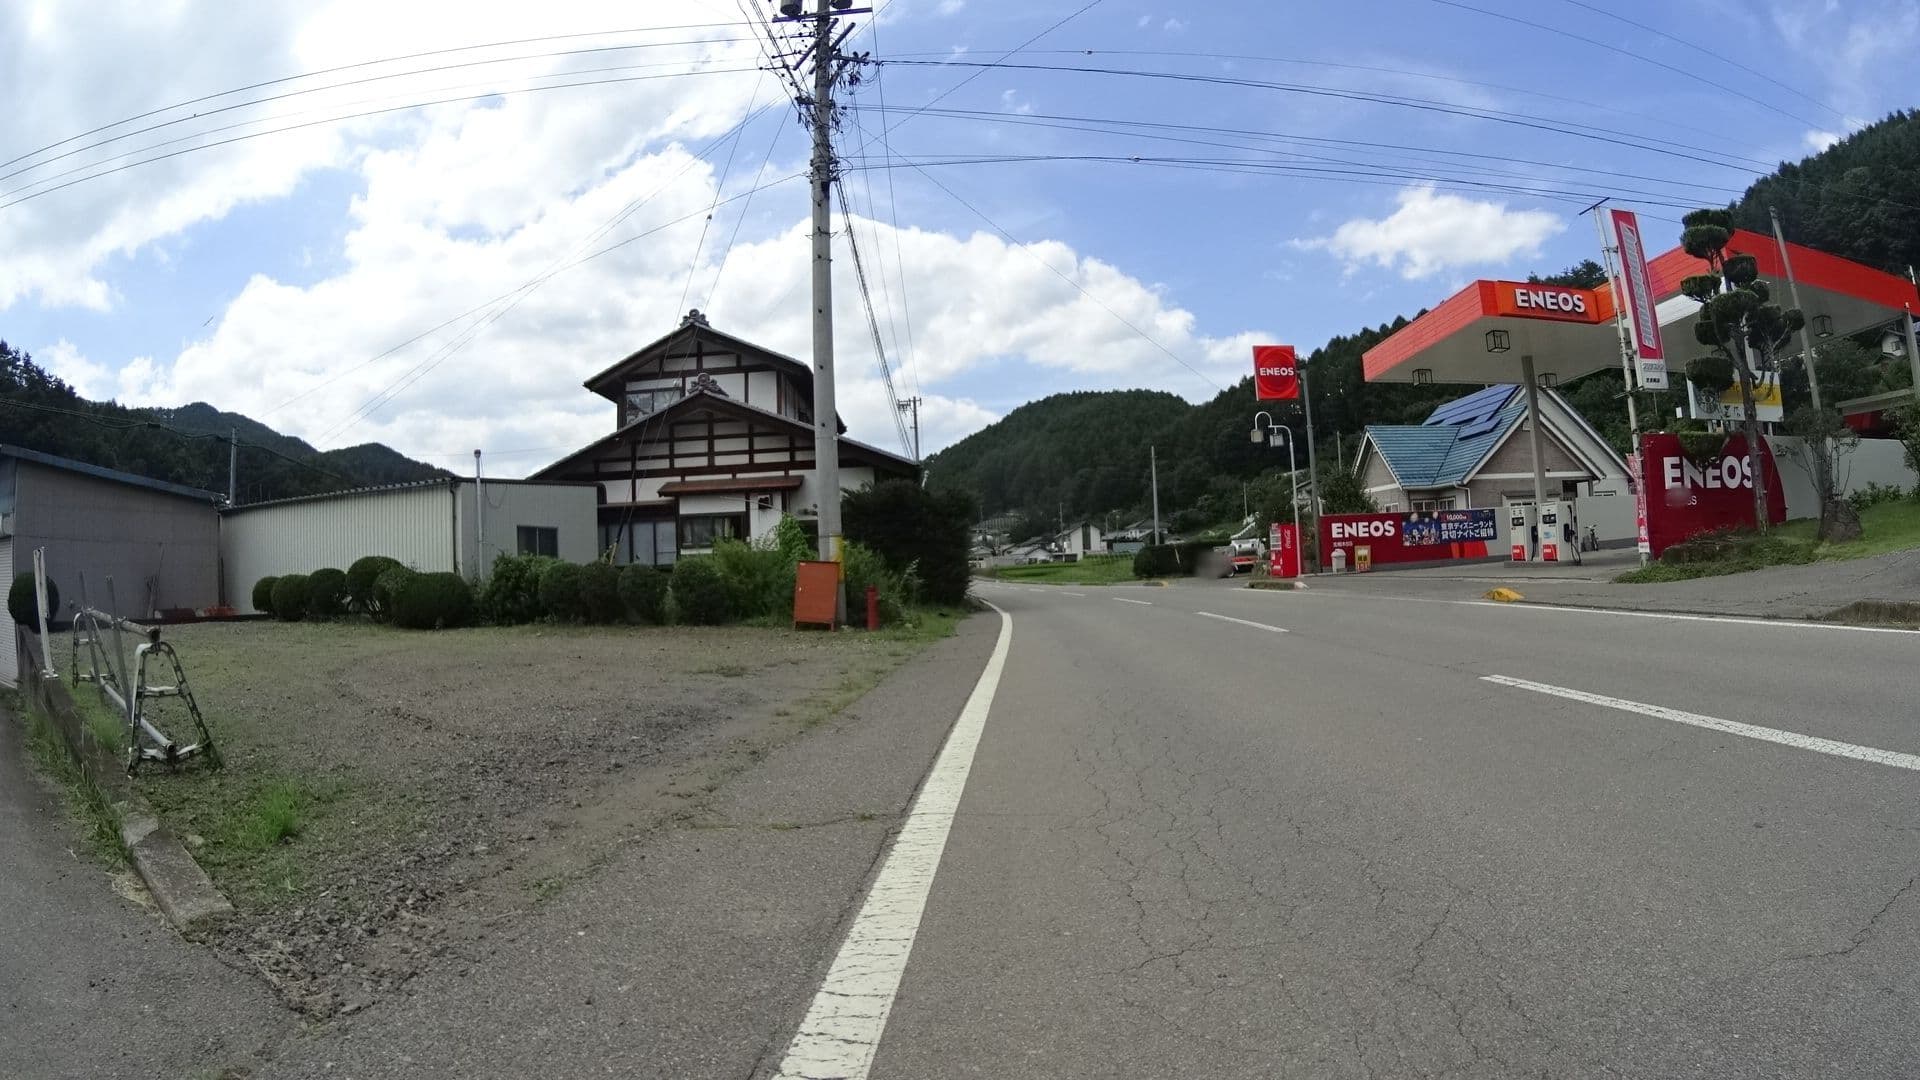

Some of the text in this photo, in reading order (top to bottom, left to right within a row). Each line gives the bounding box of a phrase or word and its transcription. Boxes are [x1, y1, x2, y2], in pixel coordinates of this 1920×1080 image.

[1515, 288, 1586, 313] ENEOS
[1259, 367, 1294, 376] ENEOS
[1663, 455, 1753, 489] ENEOS
[1331, 520, 1395, 539] ENEOS
